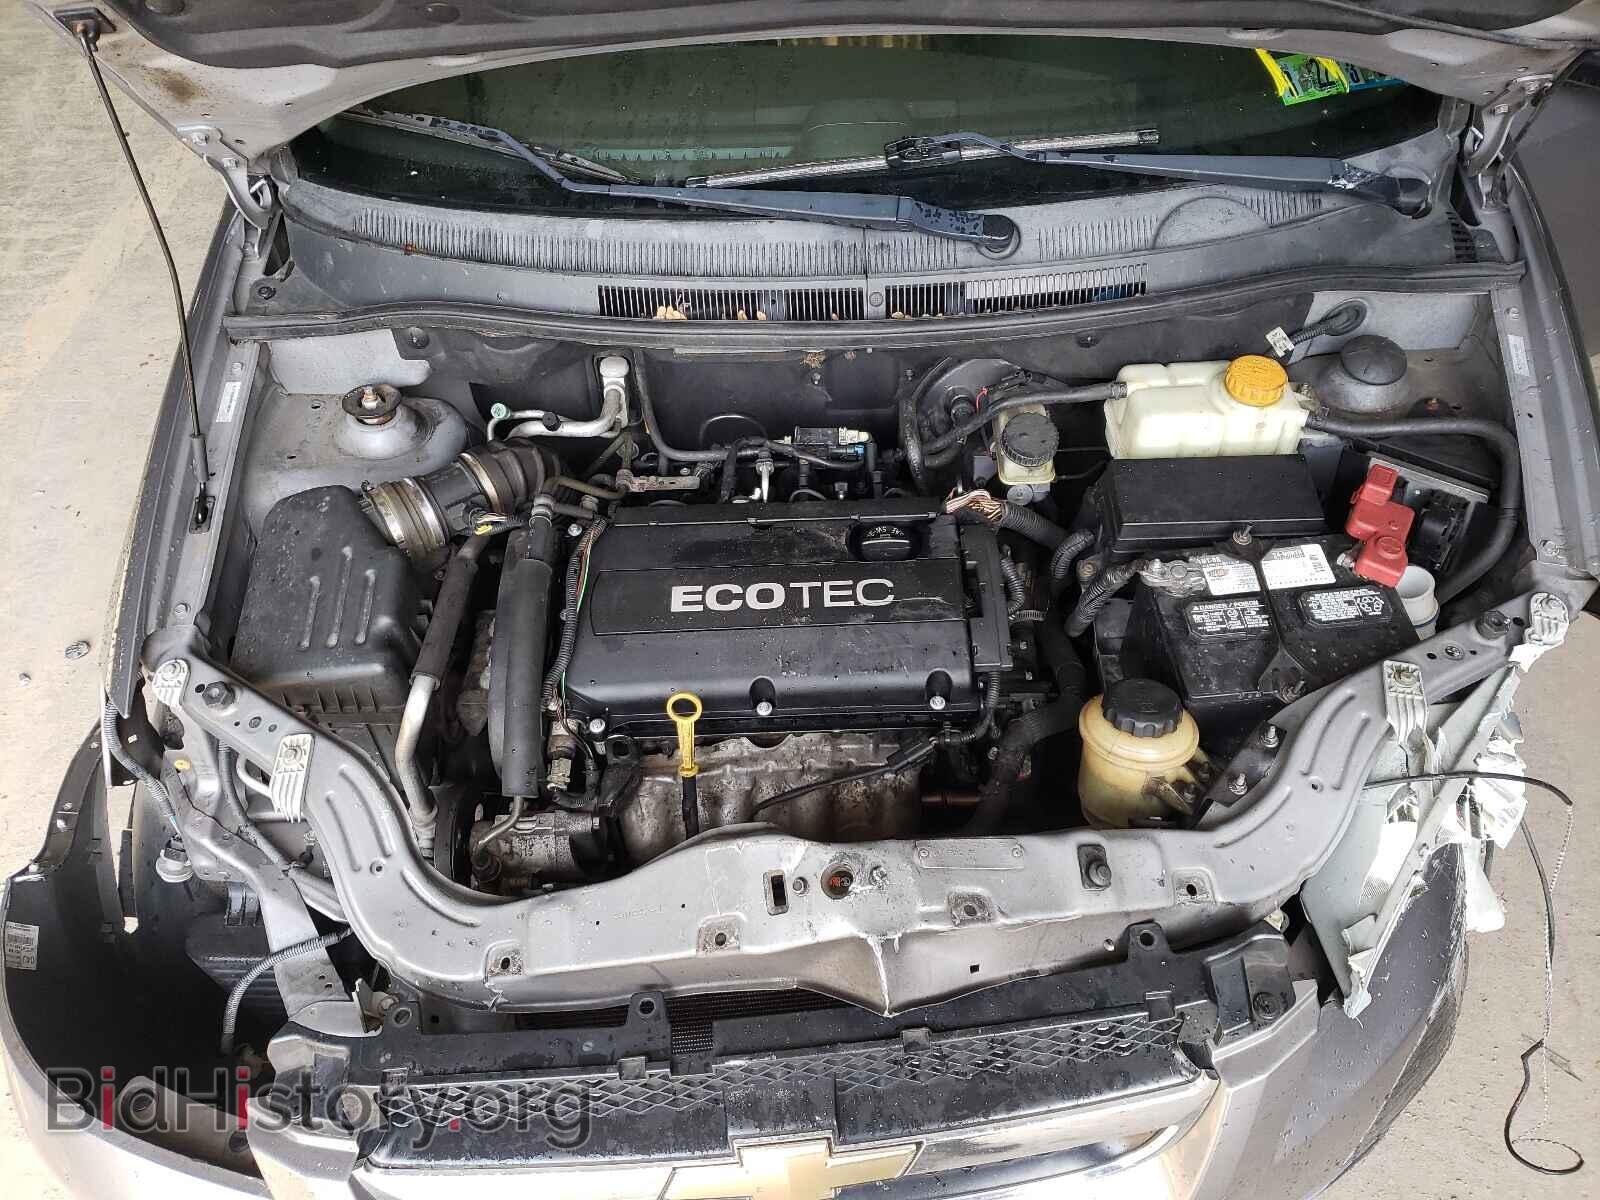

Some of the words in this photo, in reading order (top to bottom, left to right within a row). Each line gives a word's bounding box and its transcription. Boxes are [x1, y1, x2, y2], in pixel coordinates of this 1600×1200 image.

[671, 578, 895, 613] ECOTEC
[1199, 602, 1228, 611] DANGER
[1233, 599, 1259, 608] POISON
